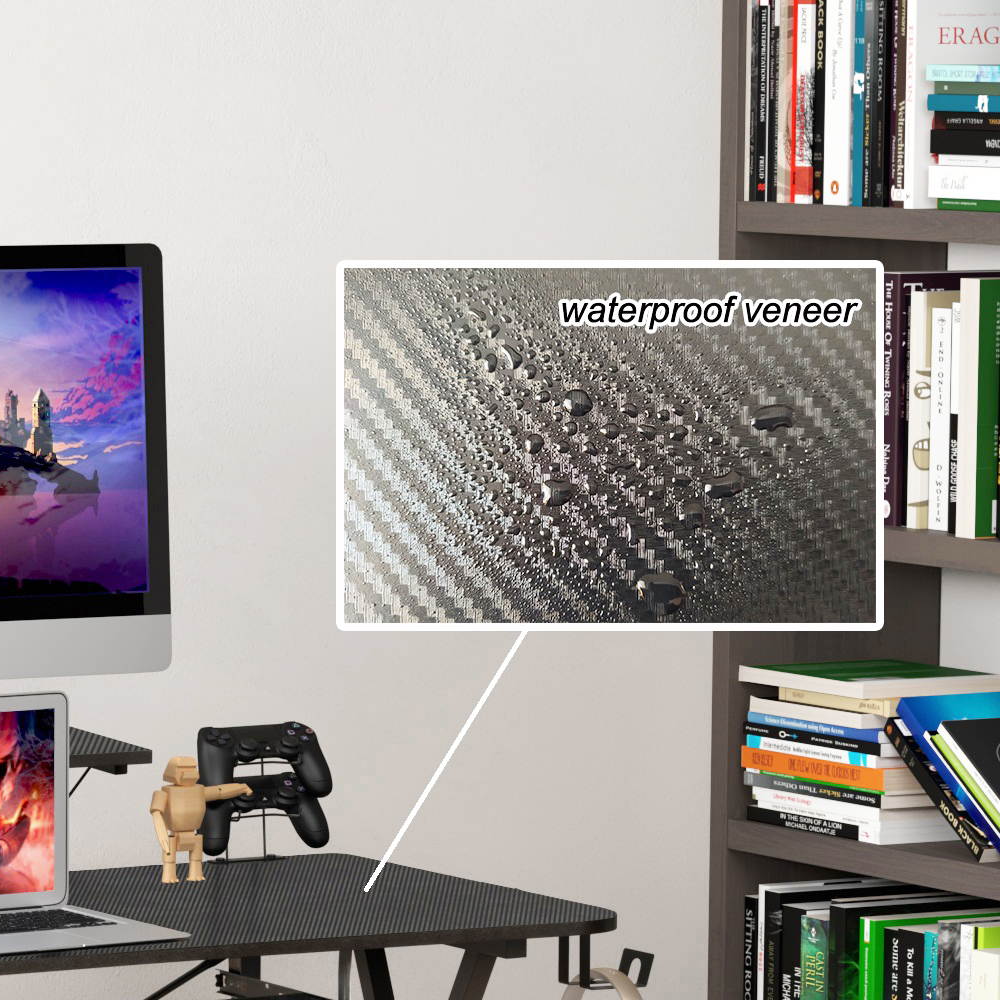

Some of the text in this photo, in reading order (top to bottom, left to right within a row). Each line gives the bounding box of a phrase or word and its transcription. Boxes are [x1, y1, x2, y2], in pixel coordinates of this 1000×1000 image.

[817, 31, 825, 69] BOOK
[760, 83, 766, 92] OF
[884, 280, 894, 416] THE HOUSE OF TWINING ROSES
[785, 821, 837, 836] MICHAEL ONDAATJE
[799, 816, 813, 824] SKIN
[828, 821, 842, 830] LION
[939, 800, 980, 856] BLACK BOOK
[745, 909, 753, 966] SITTING
[891, 937, 899, 970] Some
[906, 947, 914, 959] To
[792, 967, 801, 977] IN
[805, 954, 817, 988] PERIL
[815, 951, 825, 993] CAST IN
[906, 961, 914, 977] Kill
[792, 978, 801, 998] THE
[890, 972, 899, 992] are
